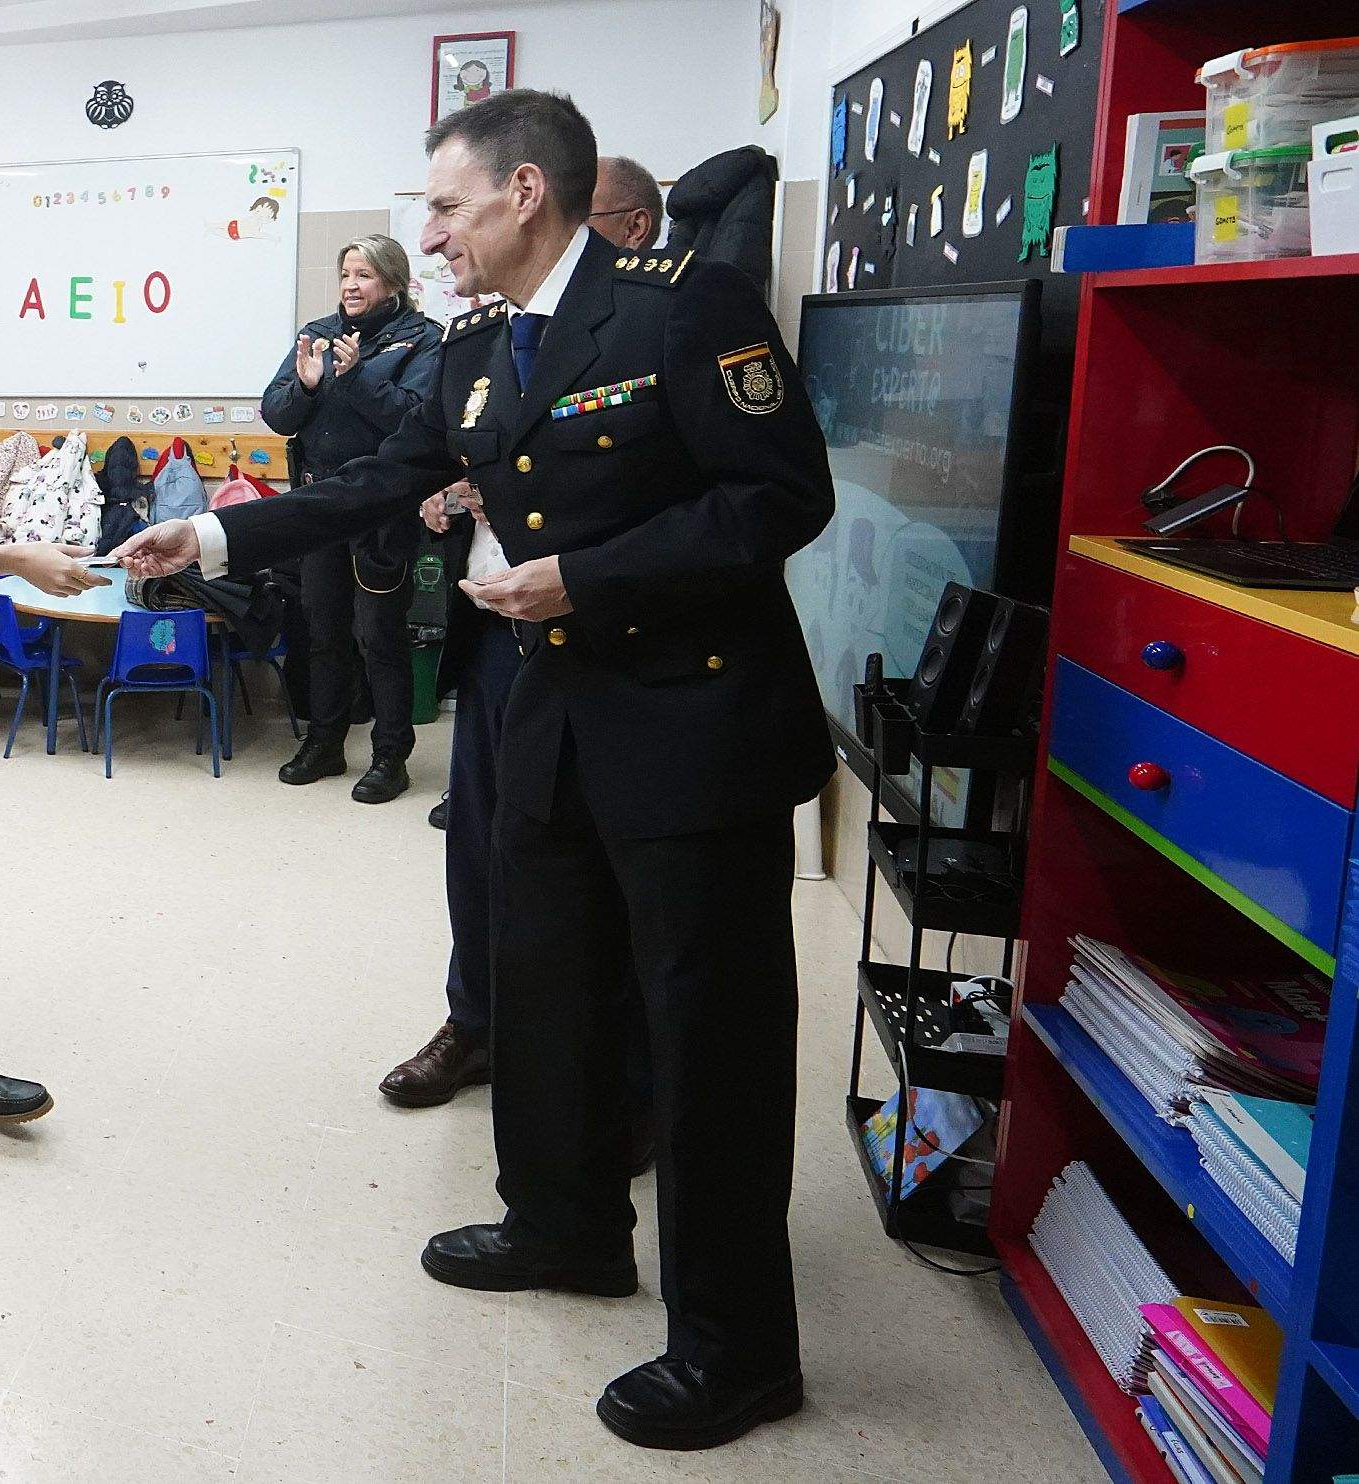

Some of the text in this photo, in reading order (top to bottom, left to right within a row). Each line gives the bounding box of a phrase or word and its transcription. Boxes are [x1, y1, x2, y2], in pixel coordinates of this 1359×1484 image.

[19, 271, 171, 324] A E I O
